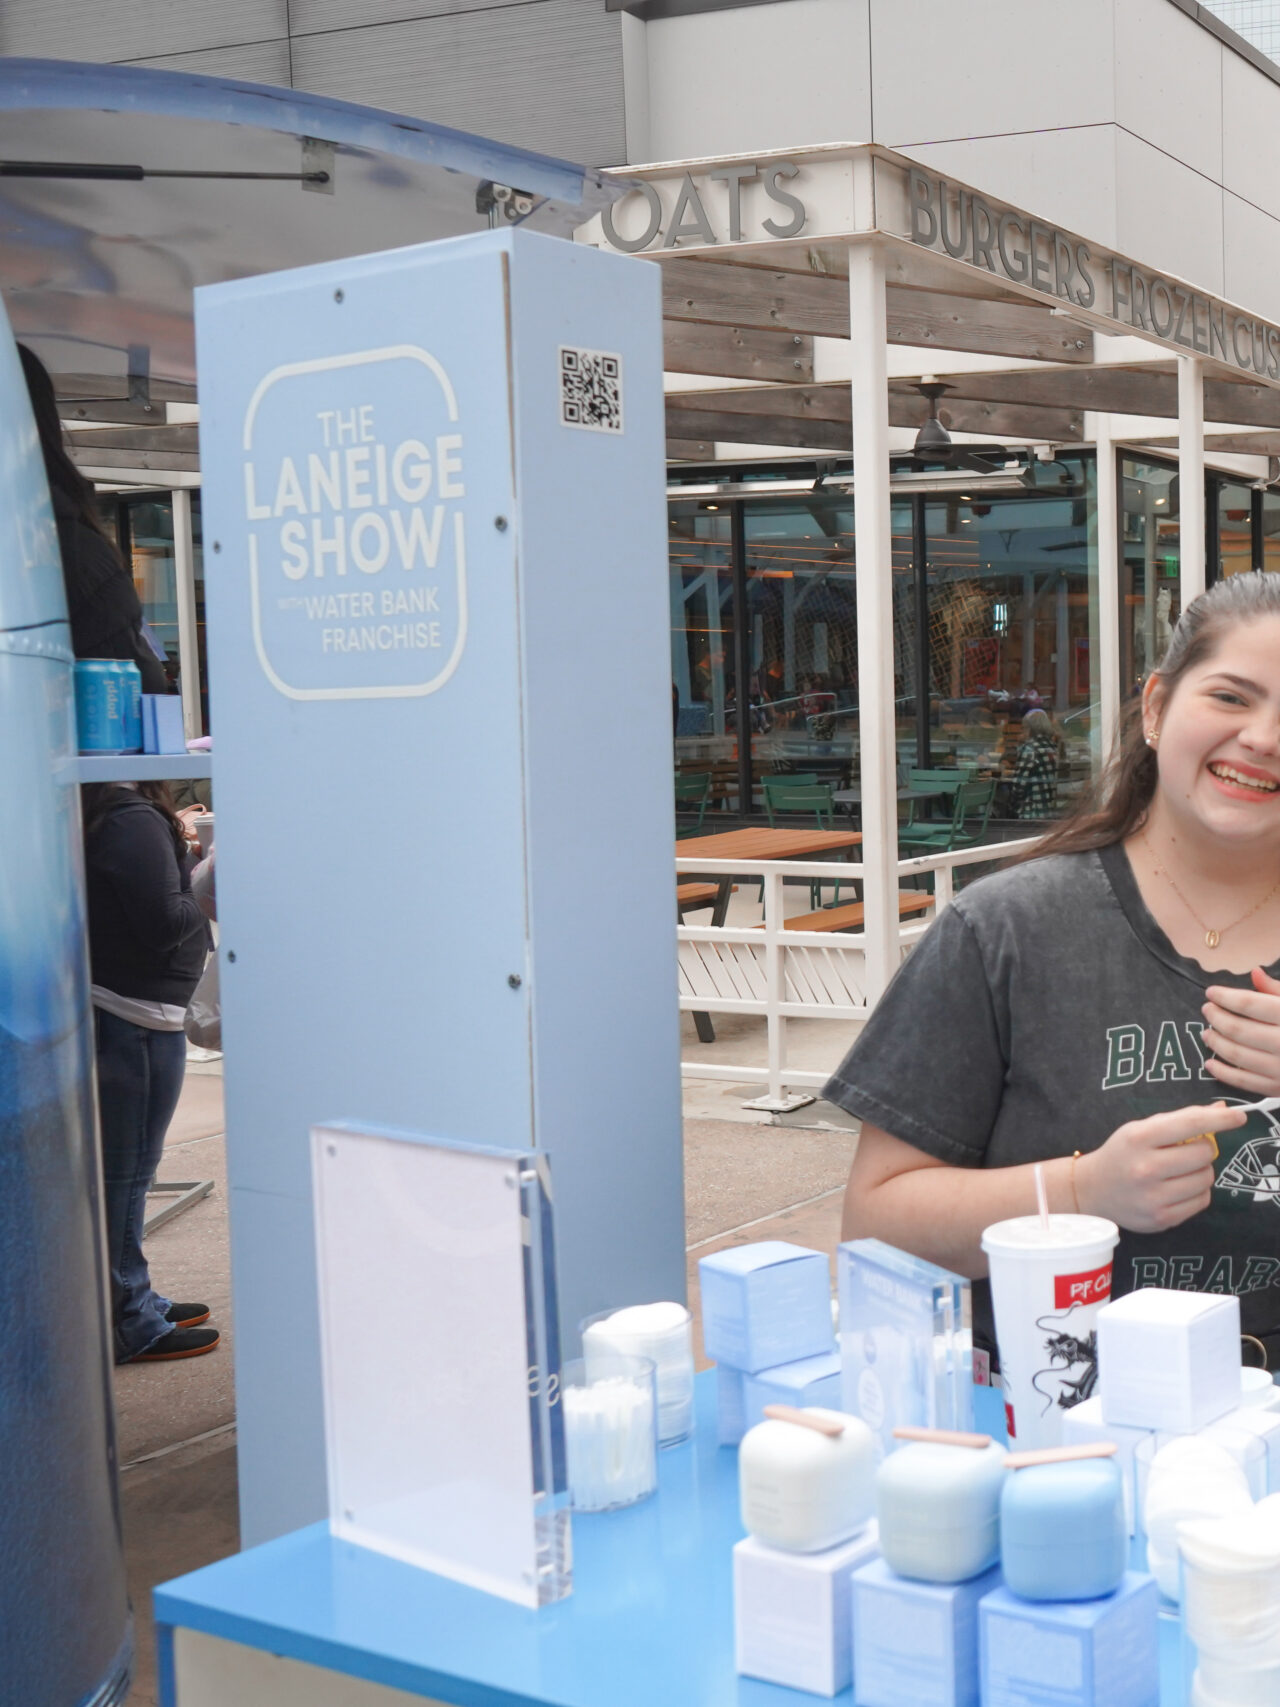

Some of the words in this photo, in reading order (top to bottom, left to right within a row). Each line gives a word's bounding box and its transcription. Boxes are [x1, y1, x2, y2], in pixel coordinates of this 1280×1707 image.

[589, 161, 806, 253] OATS
[907, 167, 1096, 309] BURGERS
[1111, 258, 1228, 361] FROZEN
[316, 404, 376, 448] THE
[244, 434, 466, 520] LANEIGE
[280, 505, 445, 580] SHOW
[304, 591, 375, 620] WATER
[381, 587, 440, 616] BANK
[322, 622, 441, 652] FRANCHISE
